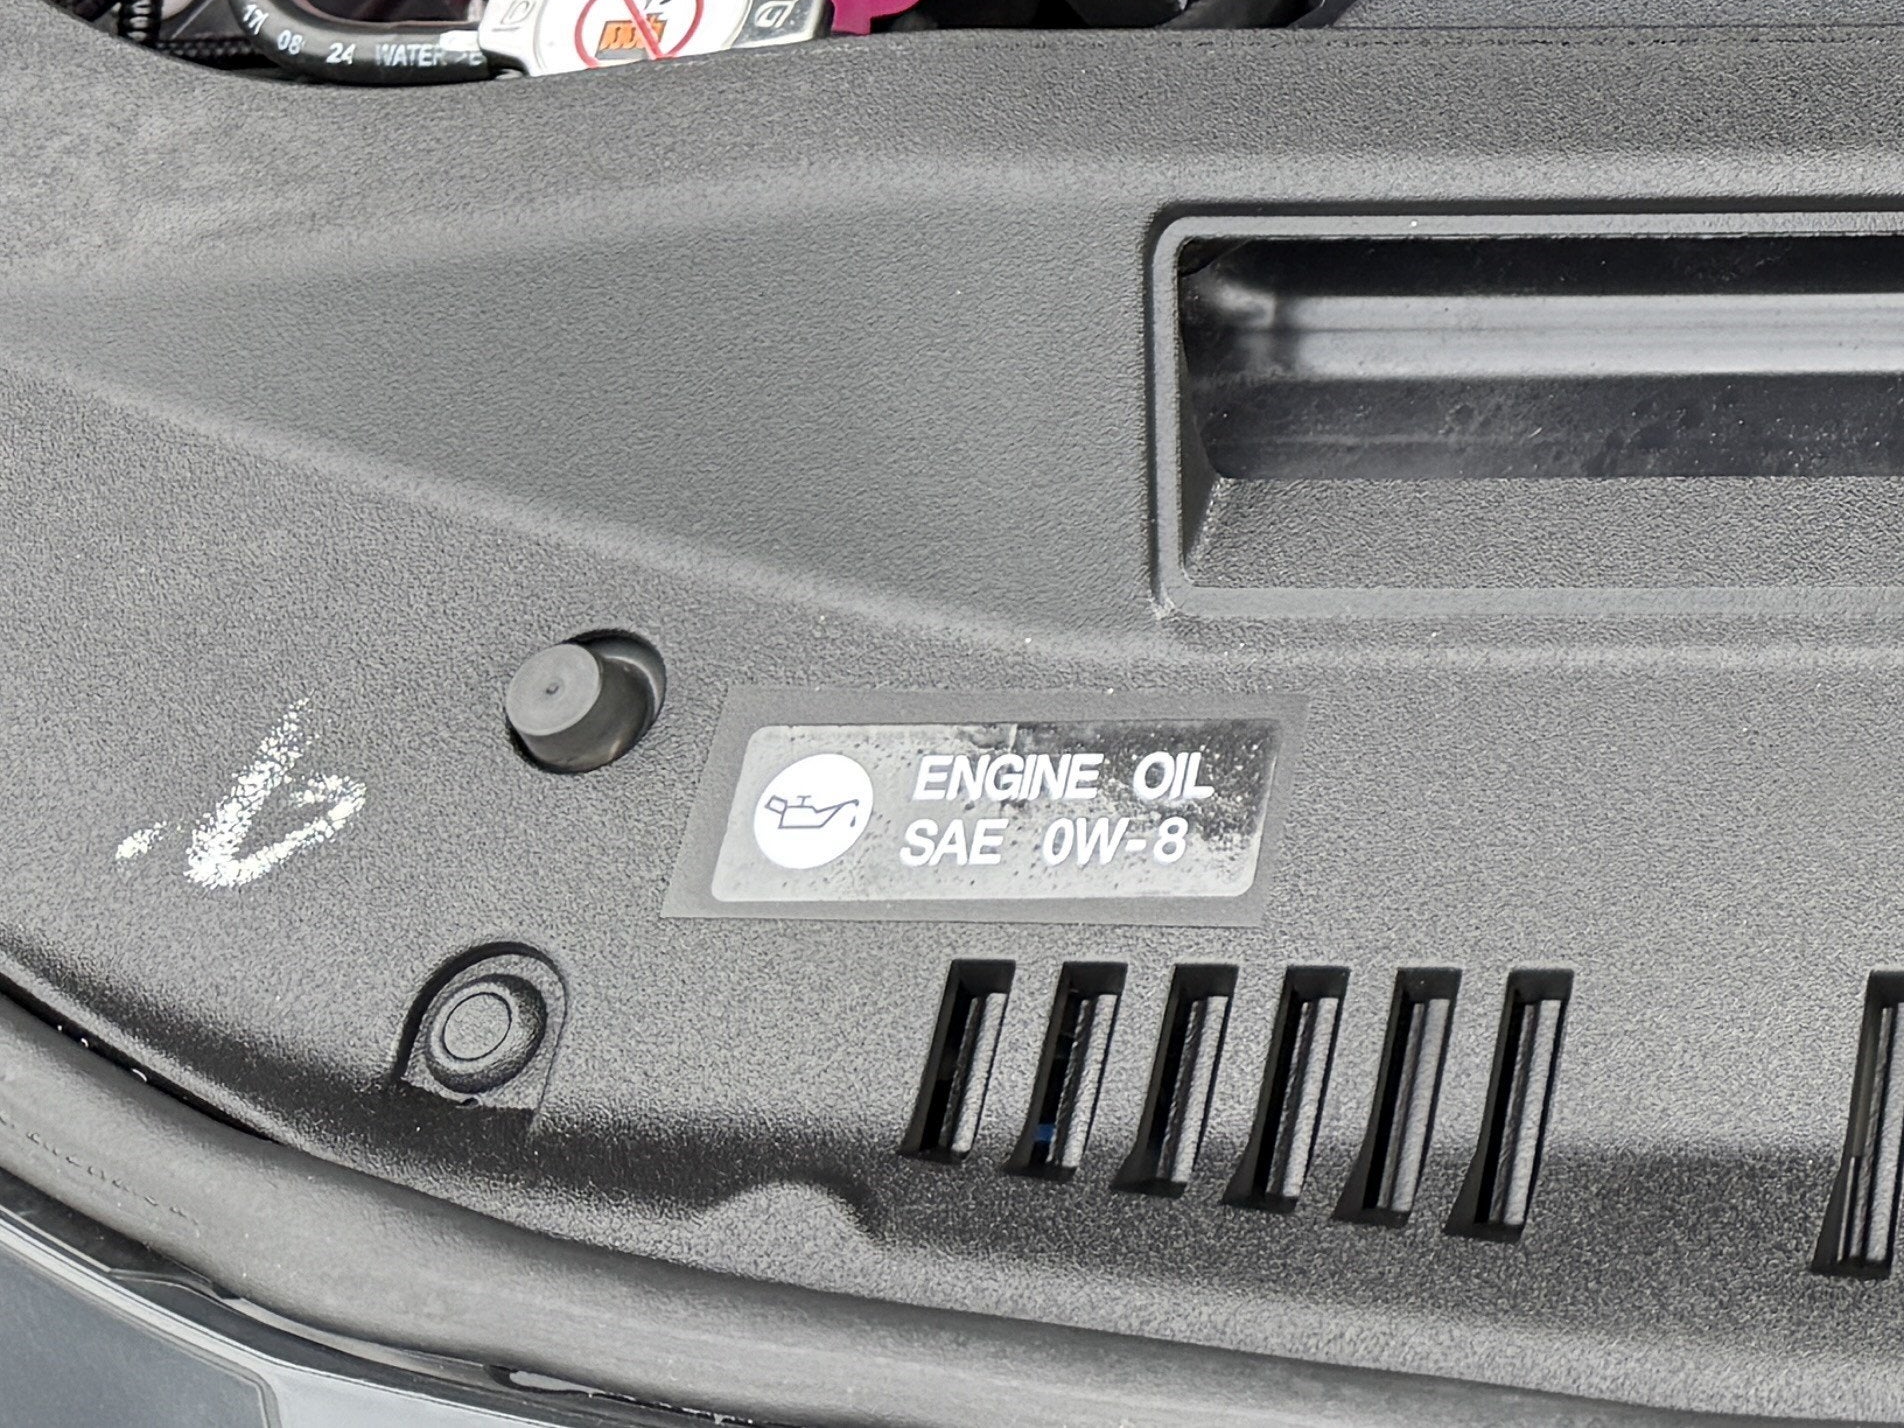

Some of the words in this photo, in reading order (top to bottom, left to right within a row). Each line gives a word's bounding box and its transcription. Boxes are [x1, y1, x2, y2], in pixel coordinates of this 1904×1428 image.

[326, 42, 356, 65] 24
[912, 752, 1105, 801] ENGINE
[1132, 750, 1216, 801] OIL
[898, 817, 1010, 867] SAE
[1042, 815, 1190, 867] 0W-8
